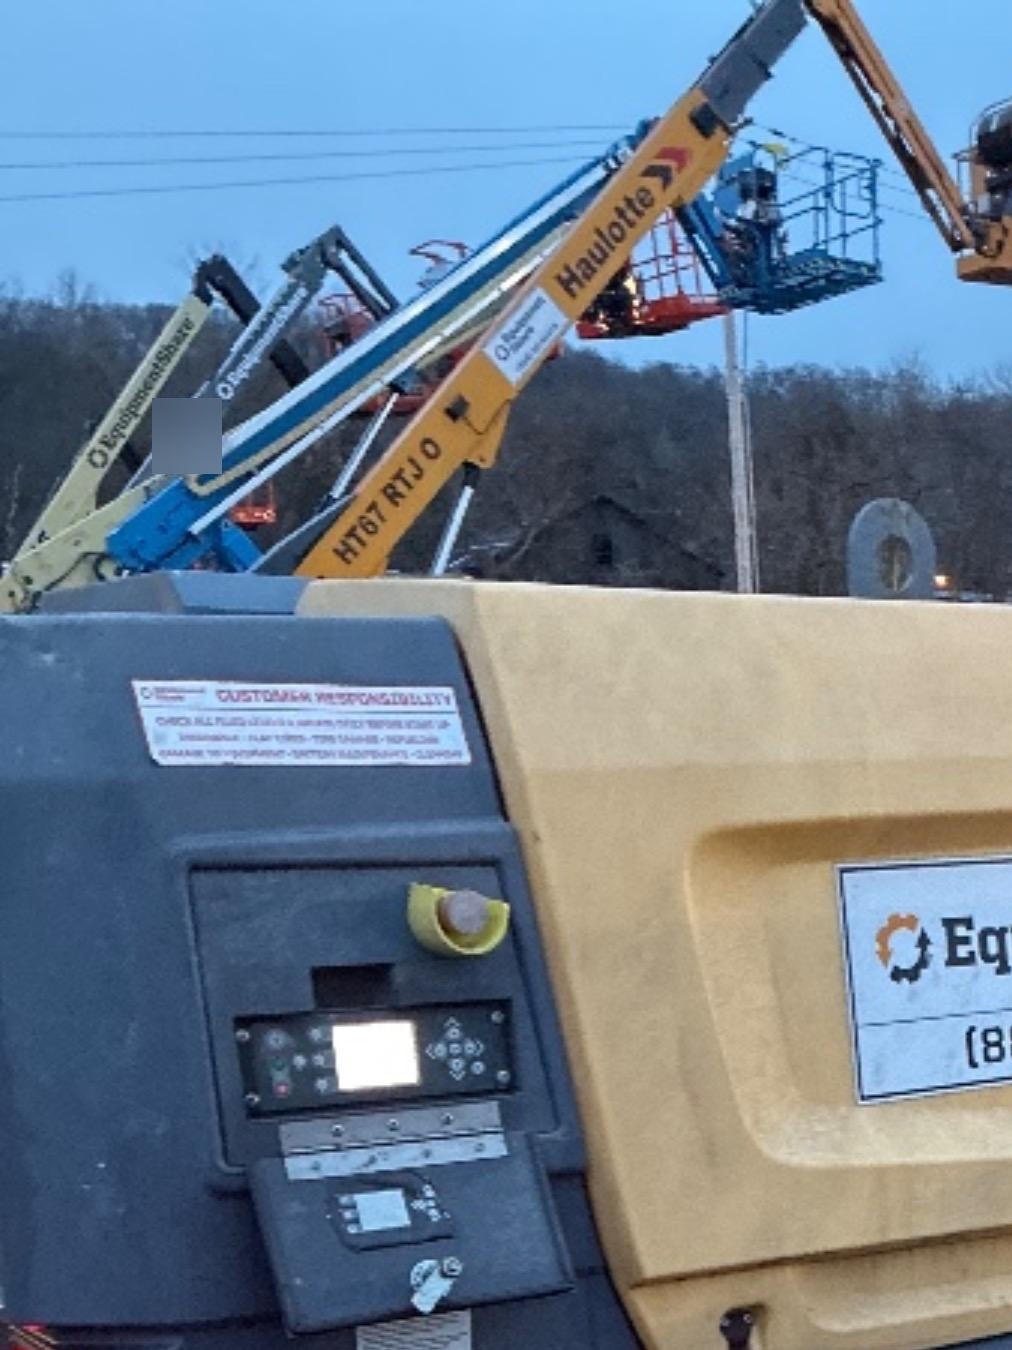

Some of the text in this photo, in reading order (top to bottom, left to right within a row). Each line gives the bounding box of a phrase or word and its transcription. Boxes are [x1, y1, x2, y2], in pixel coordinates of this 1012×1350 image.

[554, 186, 655, 299] Haulotte
[101, 317, 196, 449] EquipmentShare
[332, 500, 388, 565] HT67
[381, 455, 424, 508] RTJ
